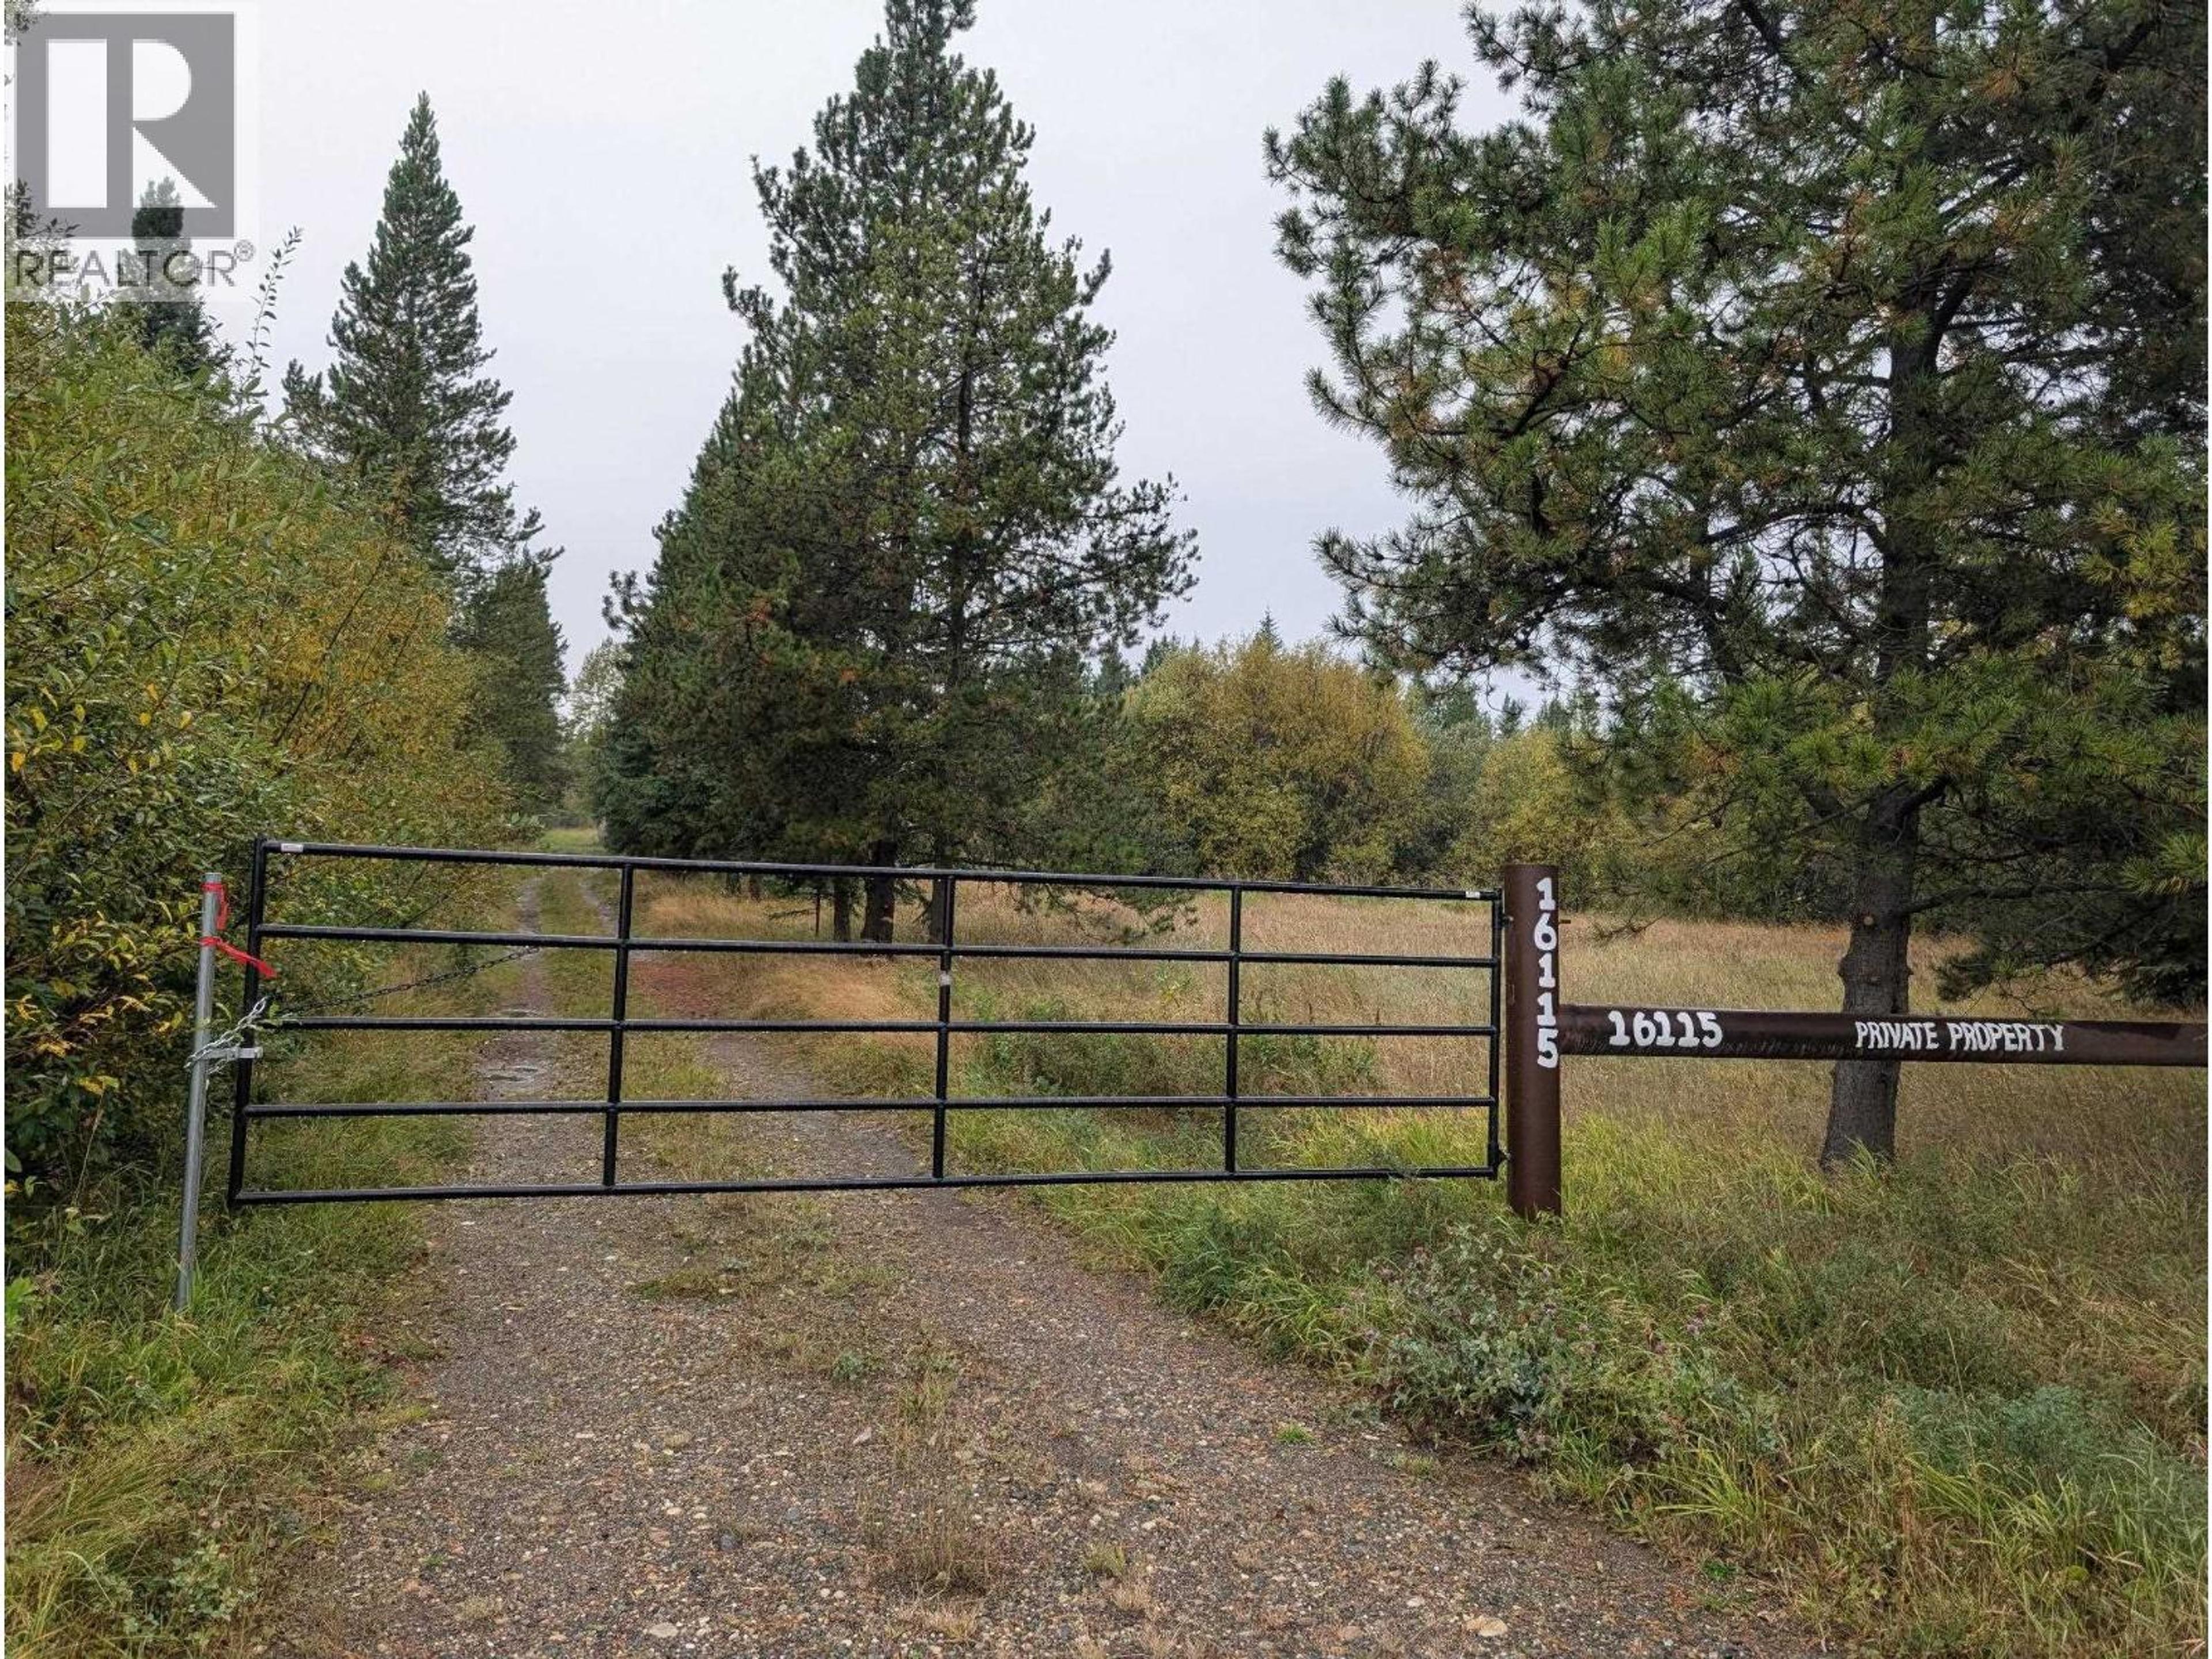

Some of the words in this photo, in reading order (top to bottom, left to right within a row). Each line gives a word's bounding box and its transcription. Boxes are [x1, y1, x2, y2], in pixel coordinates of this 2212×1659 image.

[1533, 877, 1559, 1068] 16115
[1607, 1010, 1724, 1048] 16115
[1854, 1021, 1940, 1049] PRIVATE
[1946, 1022, 2065, 1052] PROPERTY
